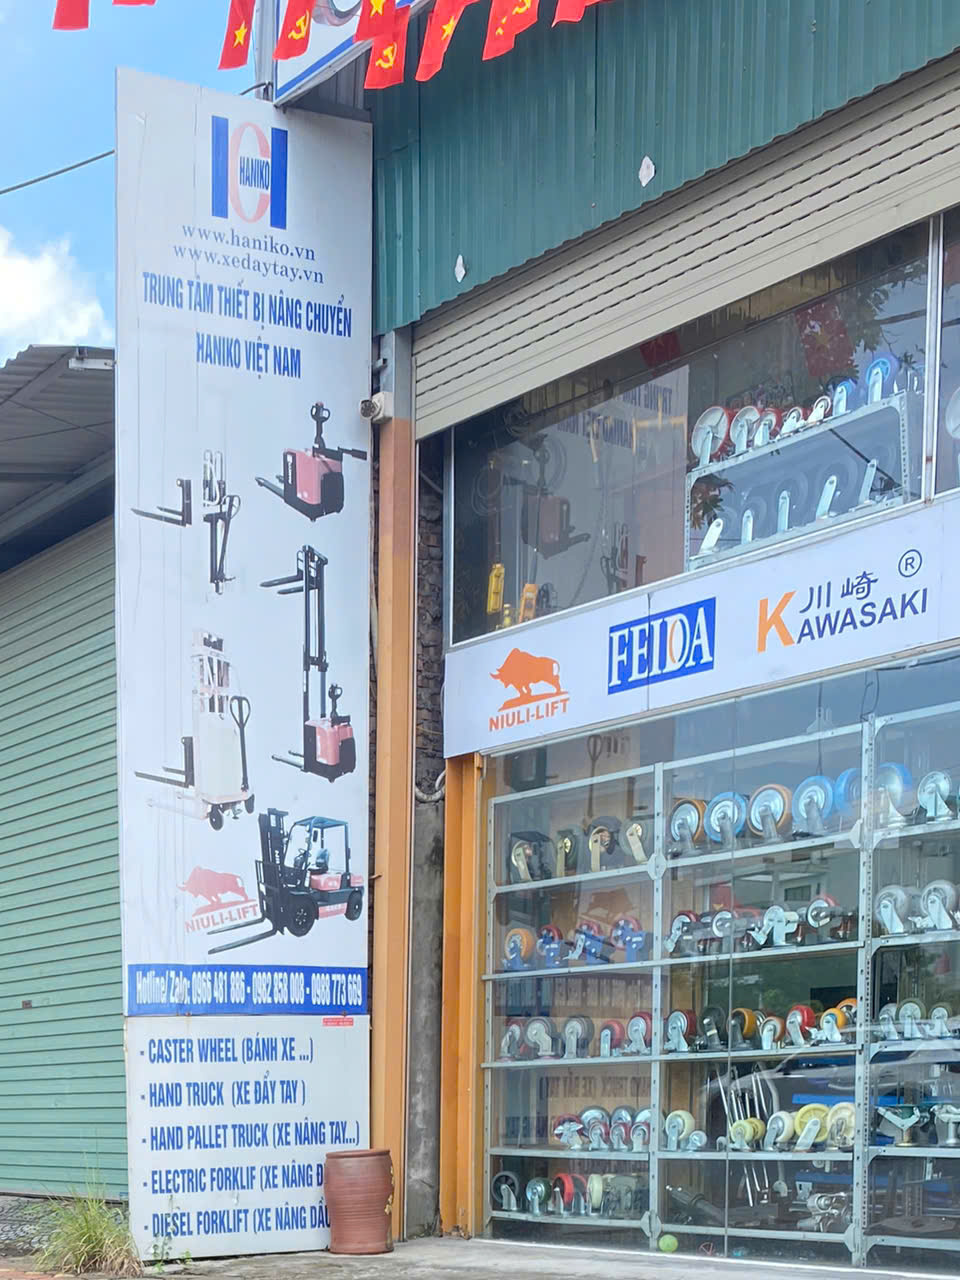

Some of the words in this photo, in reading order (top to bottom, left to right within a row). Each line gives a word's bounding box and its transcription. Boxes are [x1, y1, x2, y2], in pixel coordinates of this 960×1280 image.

[239, 156, 270, 190] HANIKO
[182, 224, 316, 261] www.haniko.vn
[173, 243, 324, 284] www.xedaytay.vn
[142, 271, 184, 309] TRUNG
[187, 274, 214, 314] TÂM
[217, 279, 250, 321] THIẾT
[253, 291, 265, 331] BỊ
[268, 289, 302, 330] NÂNG
[305, 294, 352, 338] CHUYỂN
[196, 331, 240, 369] HANIKO
[244, 335, 270, 380] VIỆT
[273, 345, 301, 379] NAM
[756, 587, 929, 654] KAWASAKI
[608, 606, 714, 688] FEIDA
[488, 697, 571, 732] NIULI-LIFT
[184, 903, 259, 934] NIULI-LIFT
[148, 1038, 194, 1064] CASTER
[197, 1037, 238, 1063] WHEEL
[242, 1032, 279, 1064] (BÁNH
[281, 1036, 296, 1062] XE
[148, 1081, 183, 1108] HAND
[185, 1081, 225, 1107] TRUCK
[232, 1080, 251, 1108] (XE
[254, 1070, 277, 1105] ĐẨY
[279, 1080, 299, 1105] TAY
[150, 1125, 184, 1151] HAND
[187, 1124, 228, 1150] PALLET
[231, 1123, 269, 1149] TRUCK
[272, 1122, 292, 1150] (XE
[294, 1117, 326, 1147] NÂNG
[151, 1168, 207, 1195] ELECTRIC
[210, 1166, 257, 1193] FORKLIF
[259, 1165, 279, 1193] (XE
[281, 1159, 313, 1189] NÂNG
[152, 1211, 194, 1239] DIESEL
[196, 1208, 249, 1237] FORKLIFT
[252, 1207, 272, 1236] (XE
[275, 1201, 307, 1232] NÂNG
